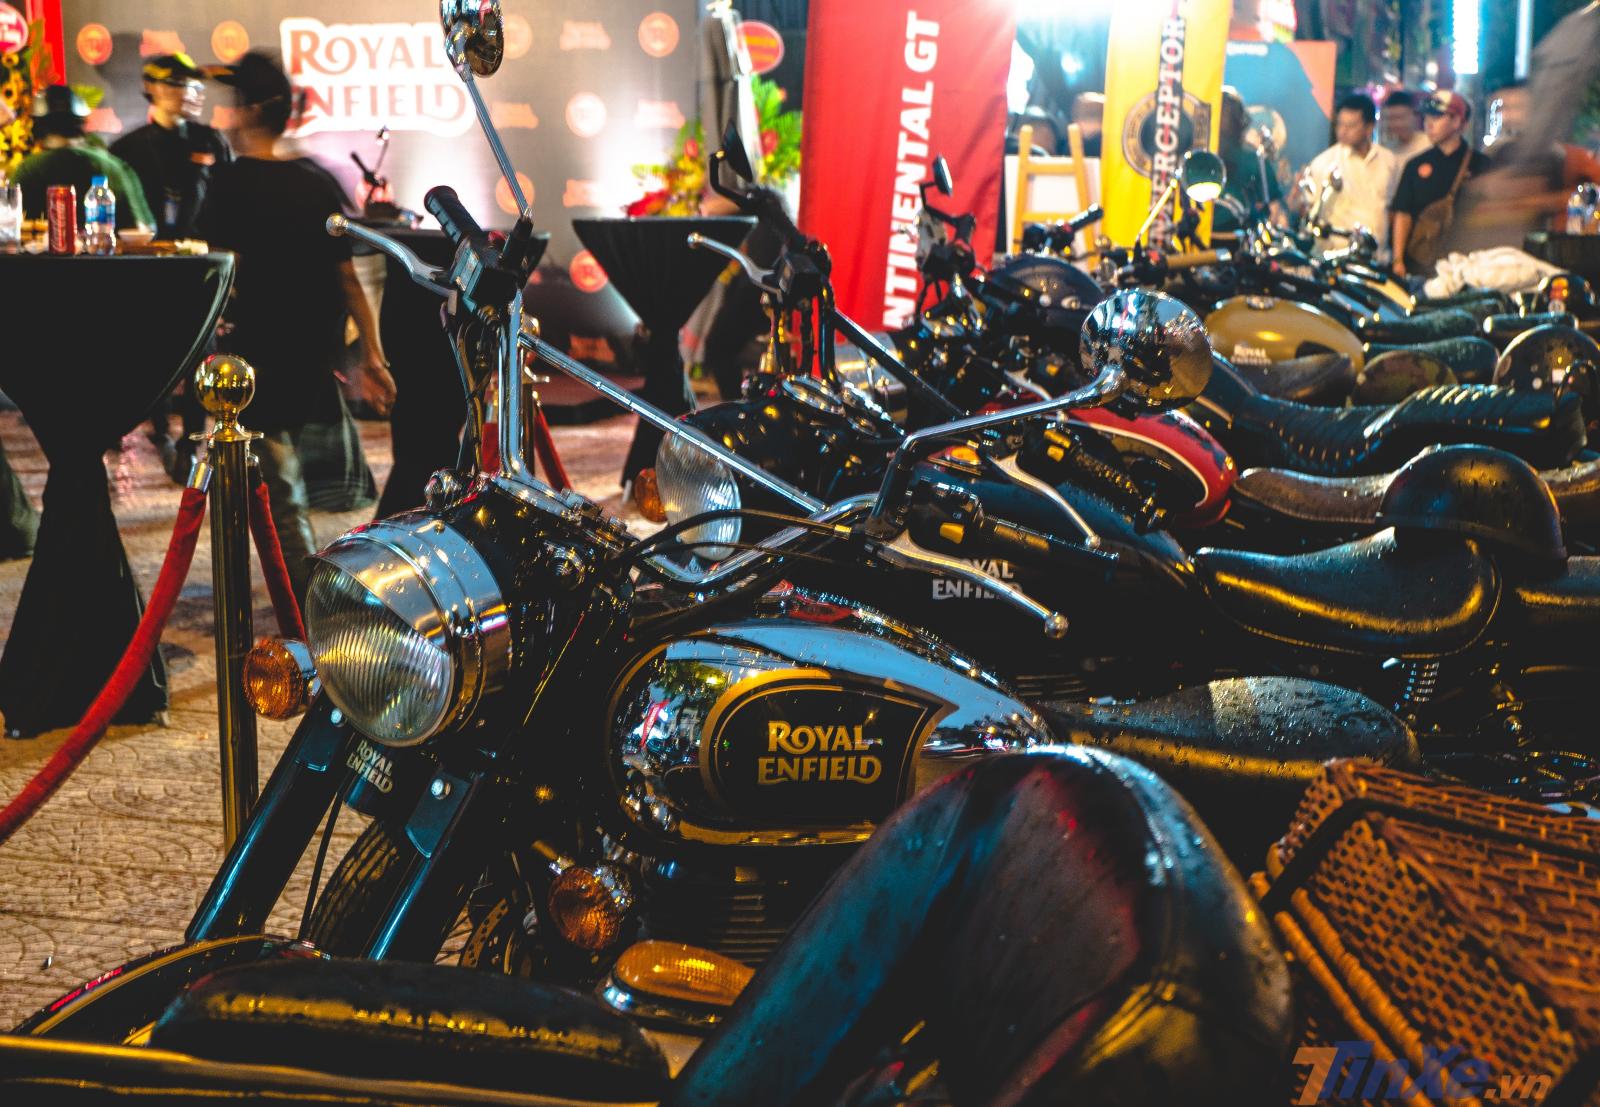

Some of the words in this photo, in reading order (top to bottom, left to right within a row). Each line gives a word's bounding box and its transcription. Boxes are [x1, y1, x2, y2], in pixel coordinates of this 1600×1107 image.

[289, 29, 444, 76] ROYAL
[903, 10, 940, 73] GT
[767, 720, 870, 755] ROYAL
[346, 752, 393, 793] ENFIELD
[357, 739, 393, 777] ROYAL
[757, 755, 882, 785] ENFIELD
